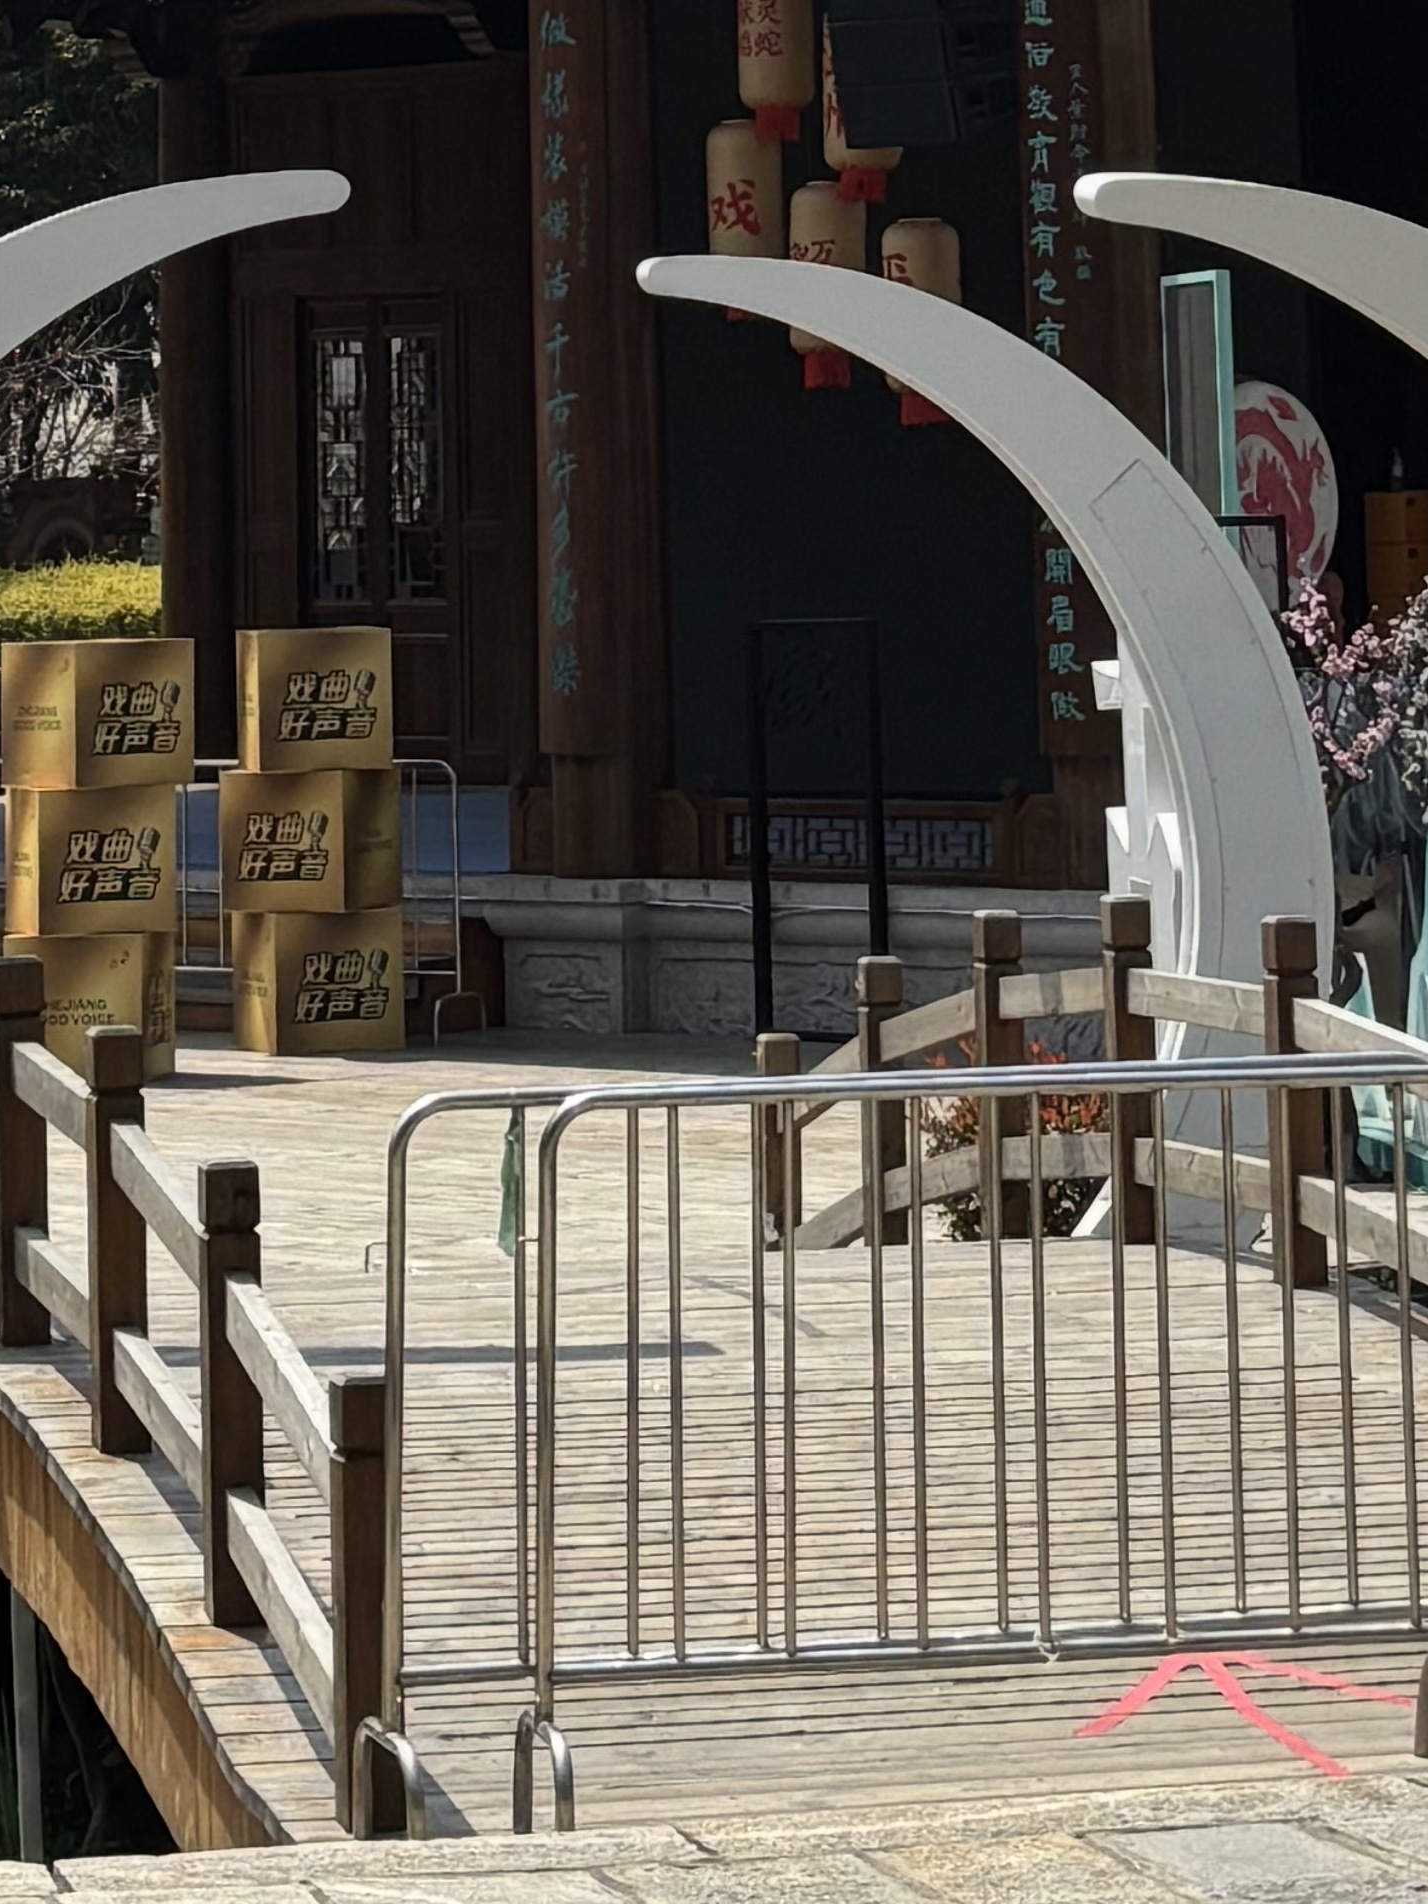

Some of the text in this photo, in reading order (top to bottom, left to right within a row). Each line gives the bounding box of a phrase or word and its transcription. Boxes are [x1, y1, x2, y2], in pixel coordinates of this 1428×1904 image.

[706, 178, 762, 237] 戏
[97, 682, 157, 718] 戏曲
[281, 668, 350, 706] 戏曲
[92, 720, 181, 755] 好声音
[277, 706, 378, 743] 好声音
[65, 827, 135, 865] 戏曲
[243, 810, 305, 846] 戏曲
[238, 847, 329, 882] 好声音
[56, 866, 161, 905] 好声音
[301, 949, 365, 986] 戏曲
[294, 987, 390, 1024] 好声音
